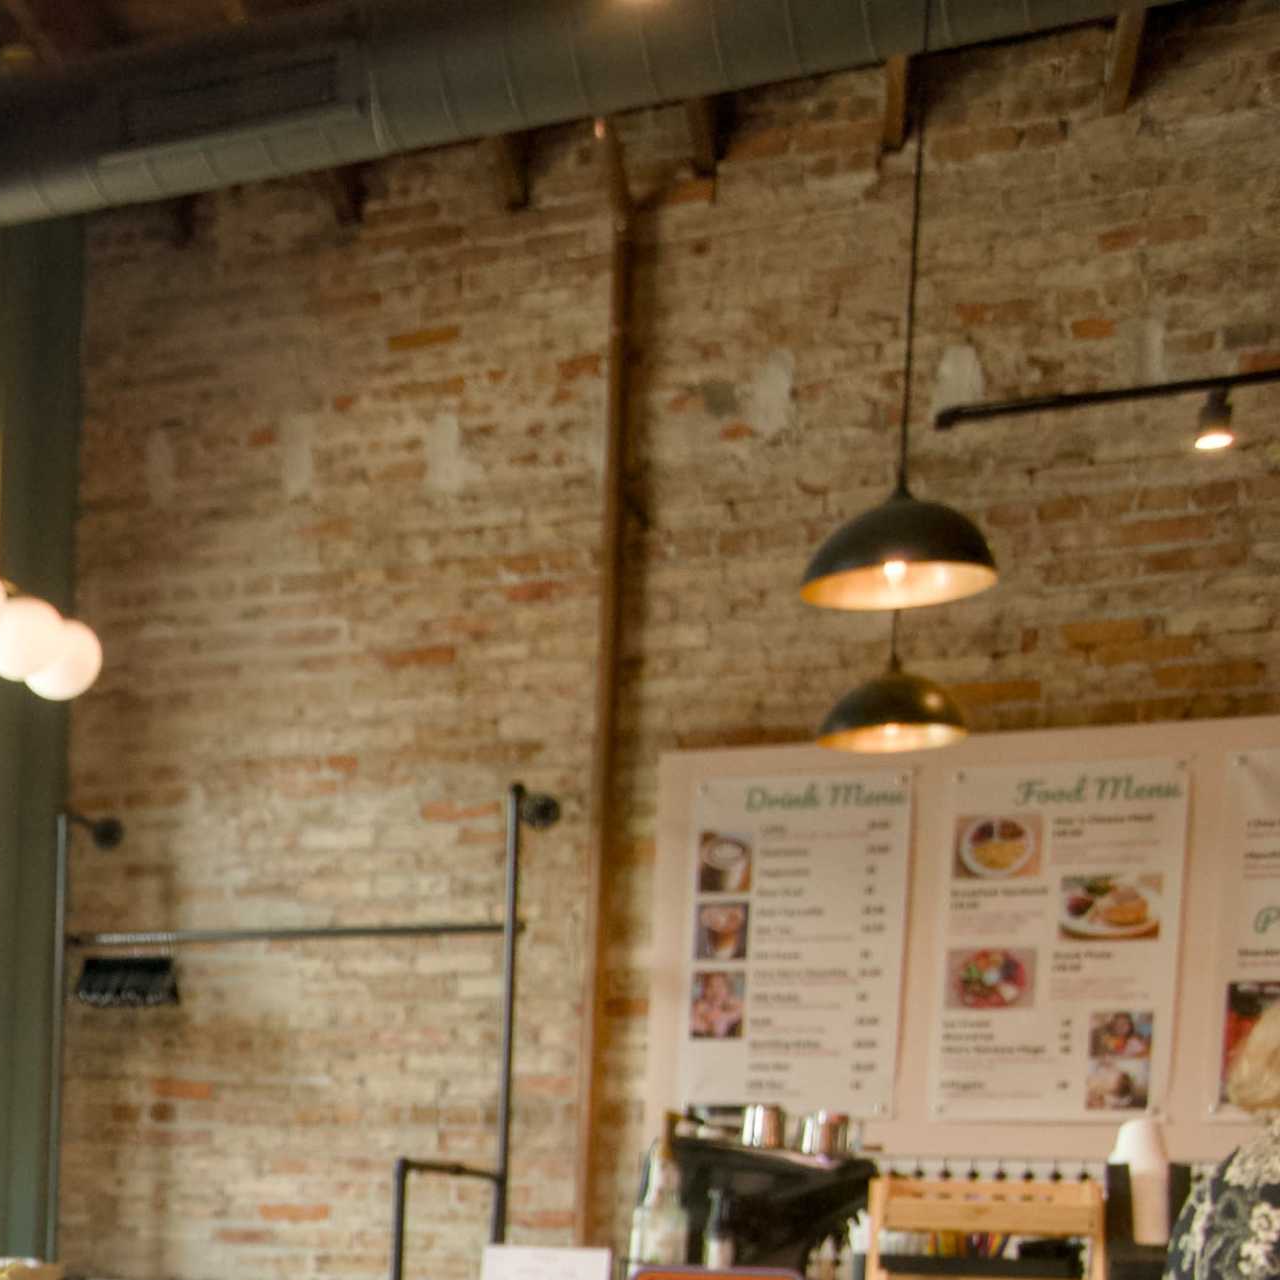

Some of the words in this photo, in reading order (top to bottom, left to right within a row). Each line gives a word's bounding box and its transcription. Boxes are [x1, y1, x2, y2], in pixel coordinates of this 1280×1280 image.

[745, 783, 818, 813] Drink
[828, 781, 906, 807] Menu
[1016, 774, 1088, 805] Food
[1094, 774, 1183, 800] Menu
